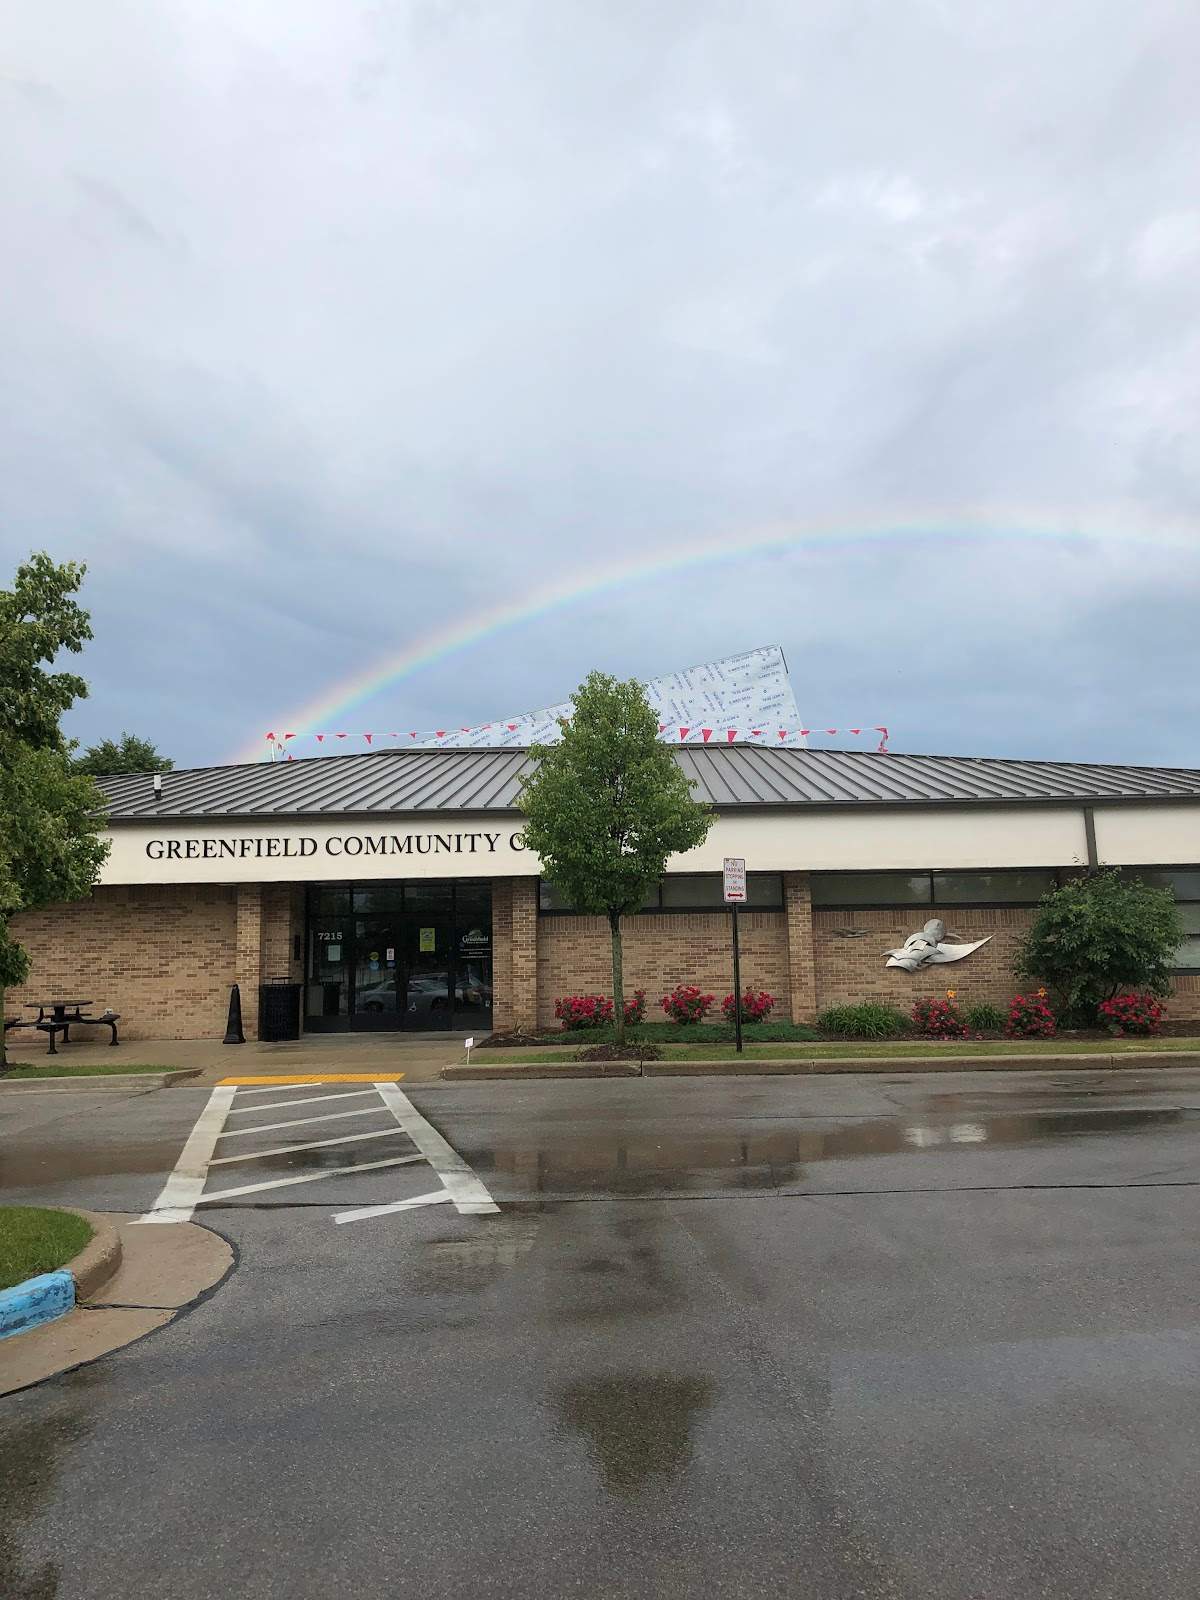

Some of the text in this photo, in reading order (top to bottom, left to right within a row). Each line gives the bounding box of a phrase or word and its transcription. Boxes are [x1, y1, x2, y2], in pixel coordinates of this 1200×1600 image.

[145, 837, 318, 860] GREENFIELD
[325, 833, 501, 856] COMMUNITY
[317, 931, 343, 941] 7215
